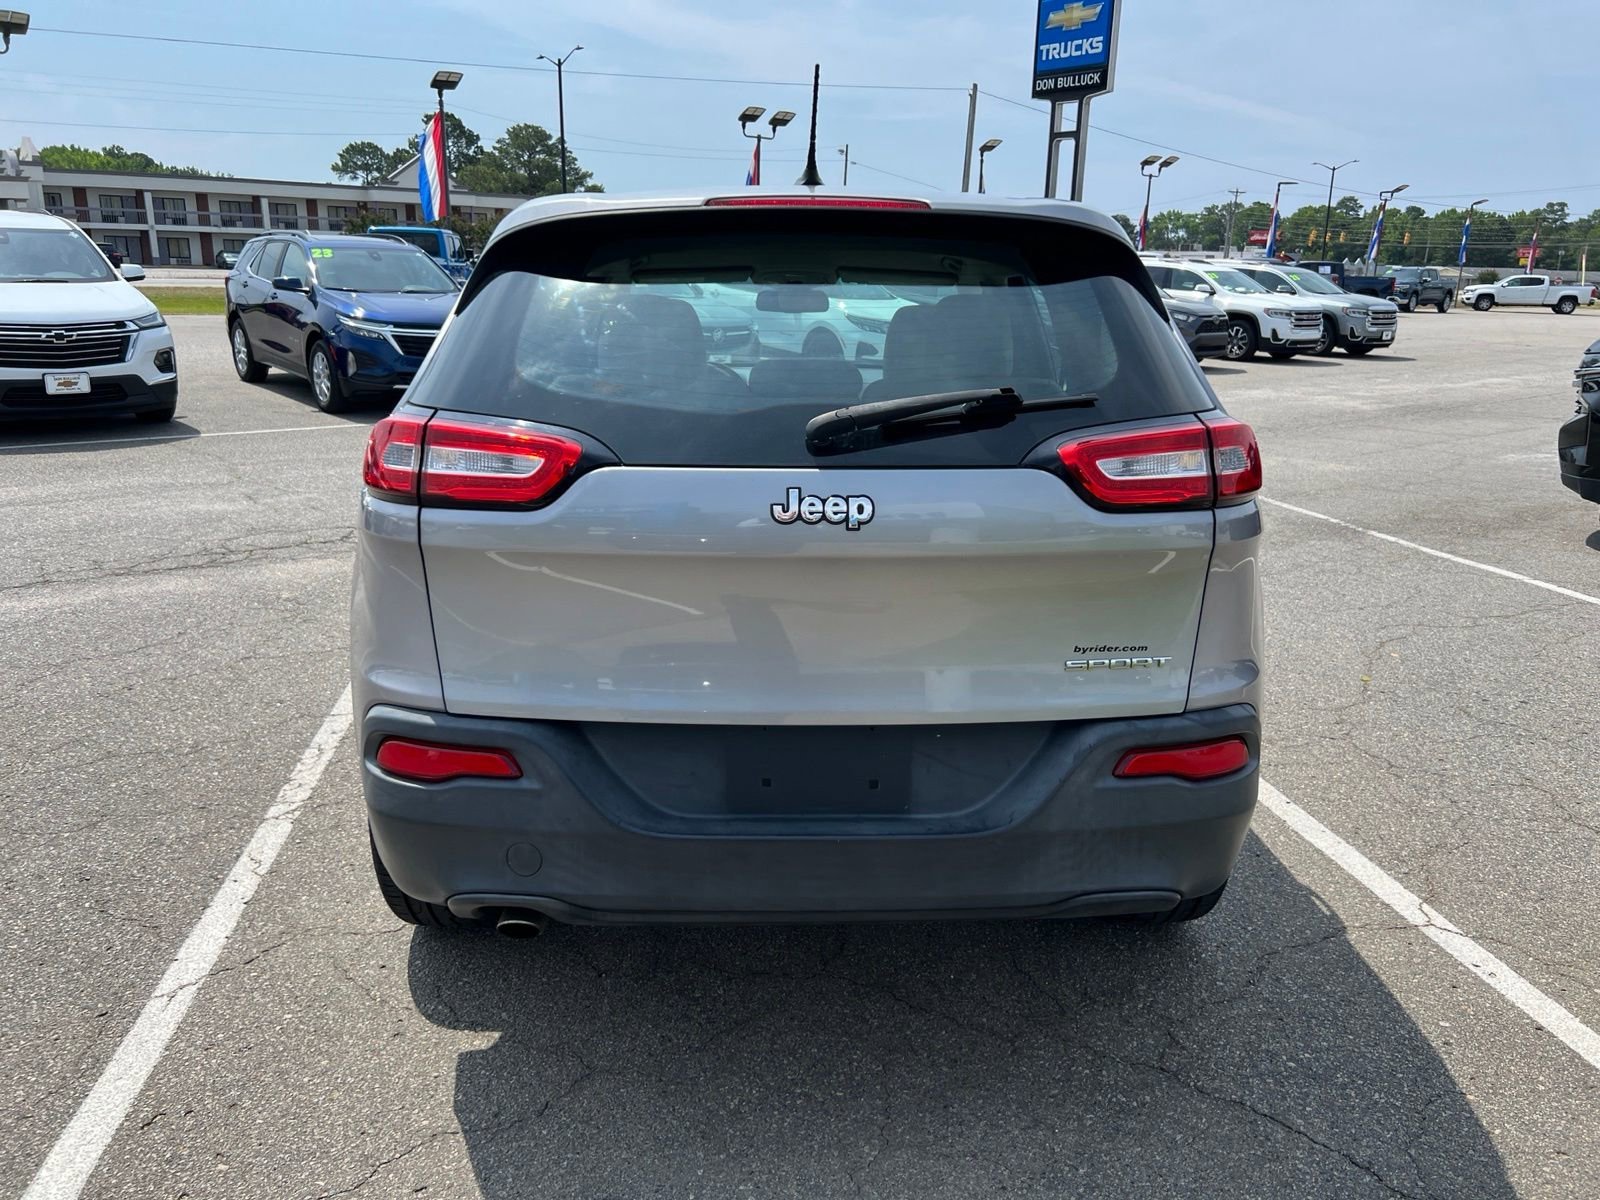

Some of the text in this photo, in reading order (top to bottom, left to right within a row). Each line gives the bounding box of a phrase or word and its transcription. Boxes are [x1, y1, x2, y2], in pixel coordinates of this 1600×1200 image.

[1040, 36, 1103, 60] TRUCKS
[1036, 72, 1101, 91] DON BULLUCK
[311, 248, 334, 258] 23
[770, 487, 875, 531] Jeep
[1073, 645, 1149, 654] byrider.com
[1064, 656, 1172, 671] SPORT
